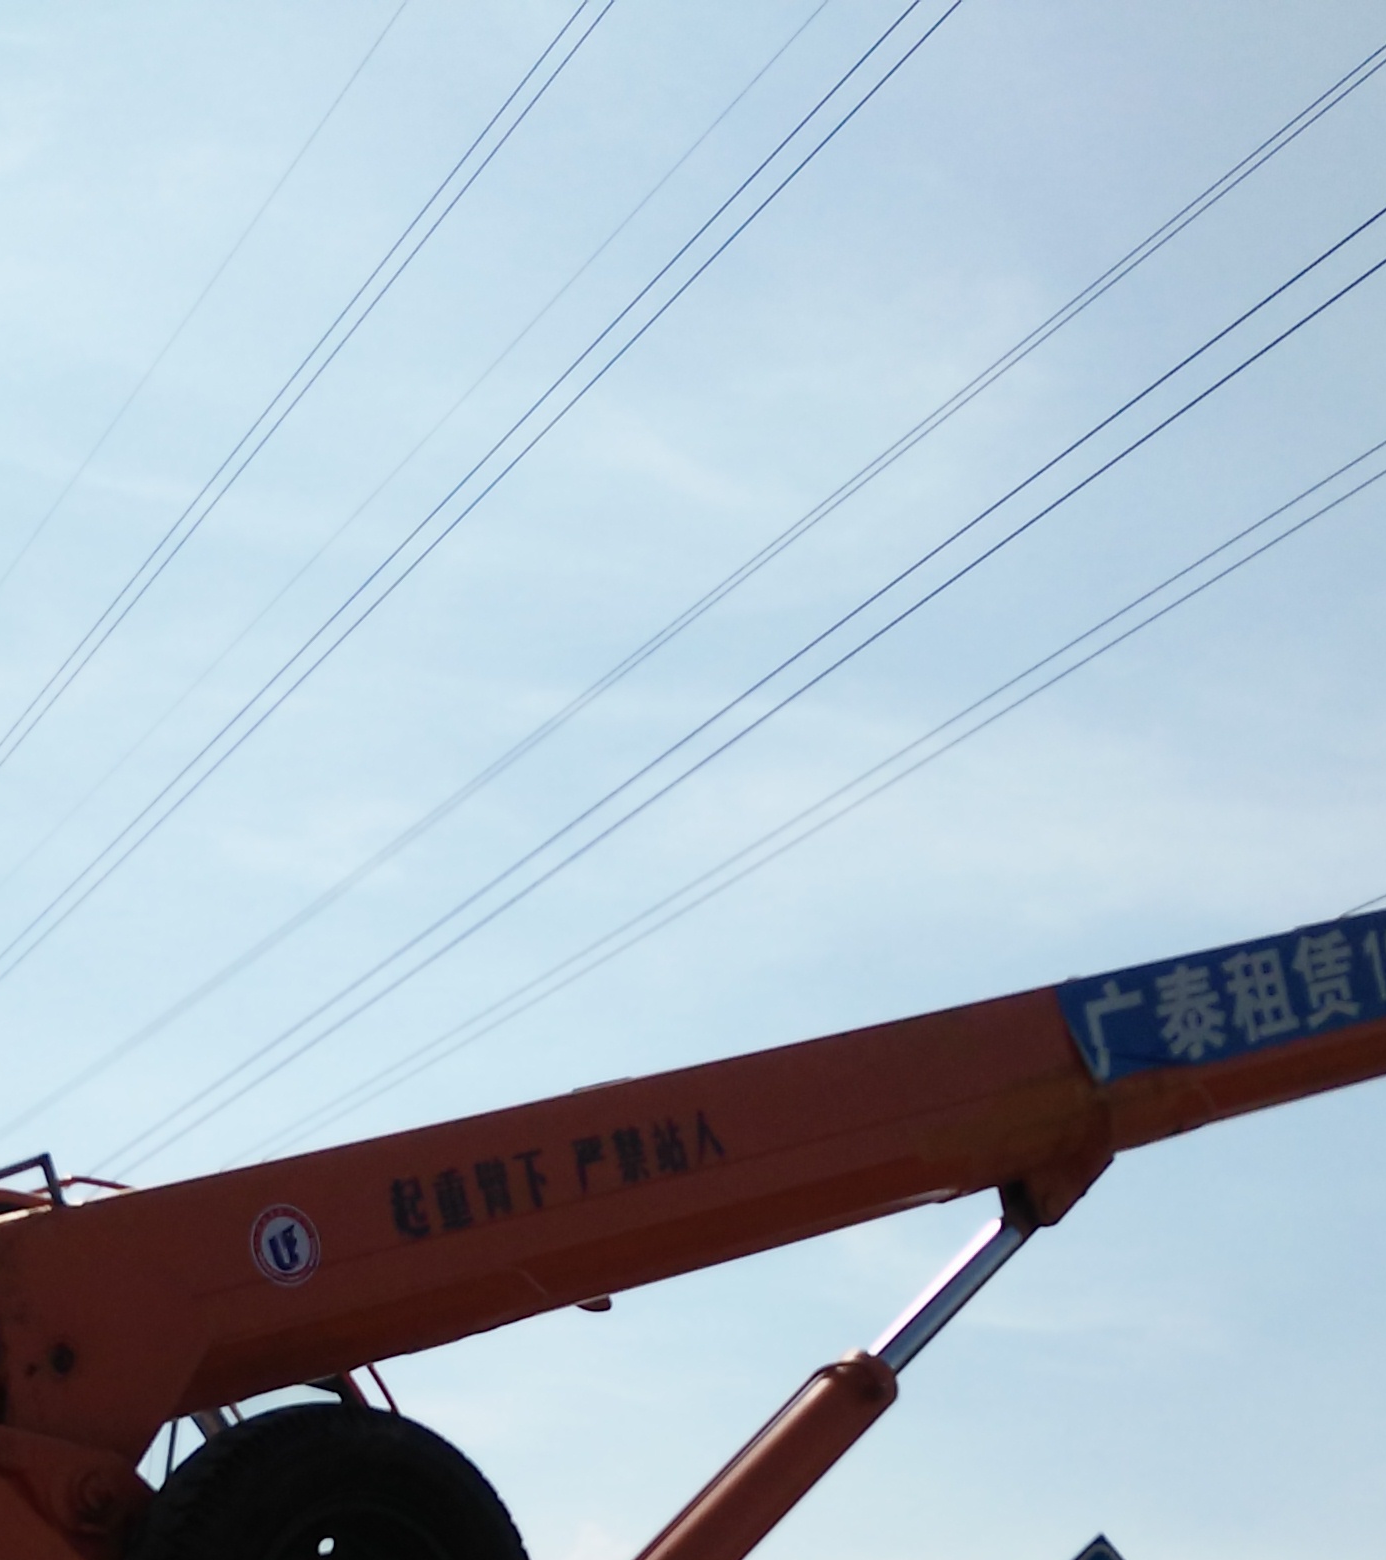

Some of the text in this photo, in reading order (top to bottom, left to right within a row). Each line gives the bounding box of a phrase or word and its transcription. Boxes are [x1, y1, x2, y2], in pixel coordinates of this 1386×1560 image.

[1084, 928, 1361, 1082] 广泰租赁
[389, 1110, 726, 1239] 起重臂下 严禁站人
